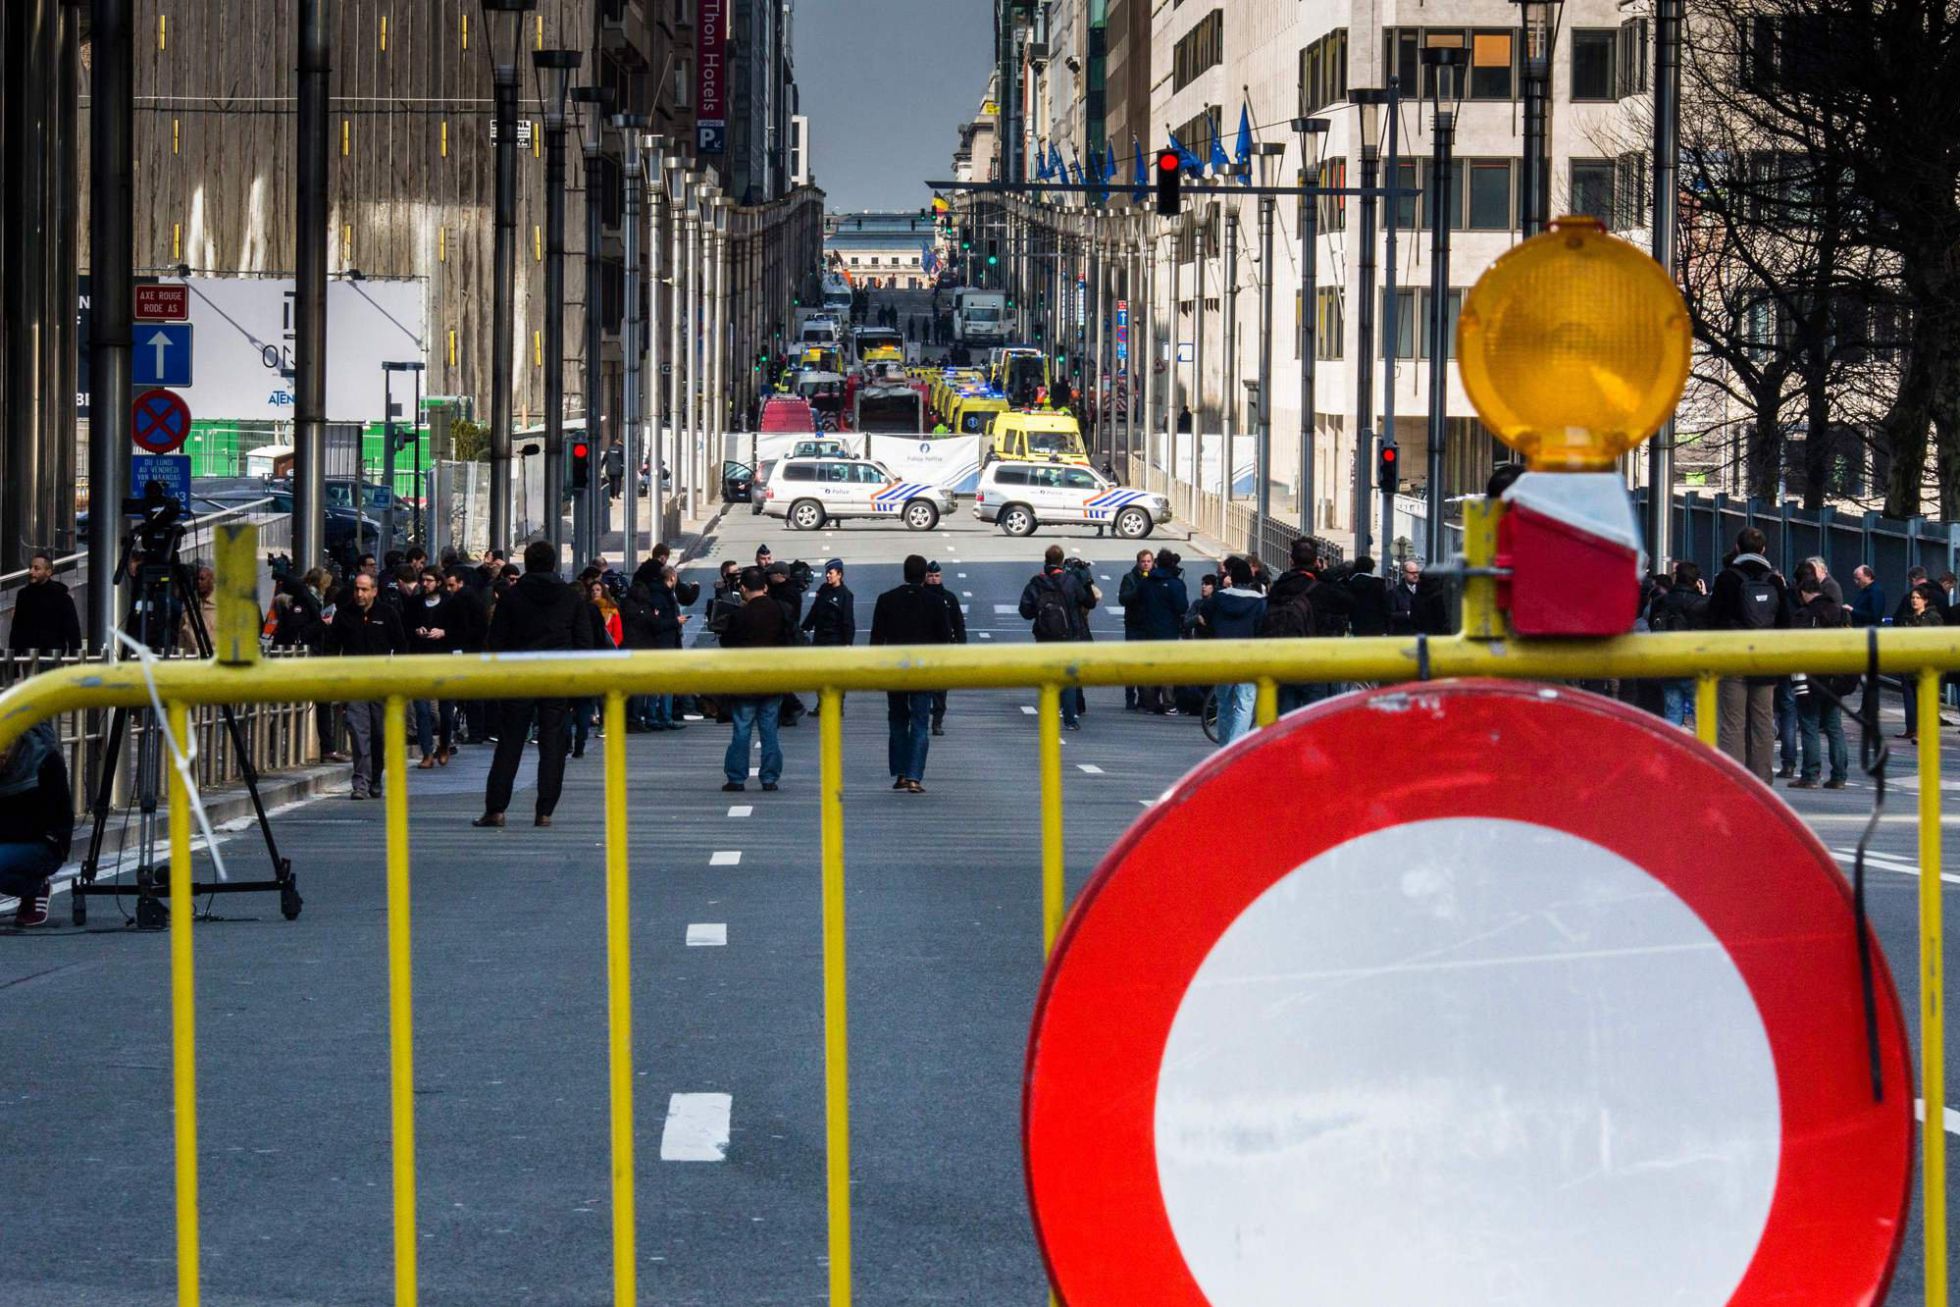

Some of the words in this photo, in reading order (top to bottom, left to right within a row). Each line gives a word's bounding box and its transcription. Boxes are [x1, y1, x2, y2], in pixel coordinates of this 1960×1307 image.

[704, 0, 720, 46] Thon
[704, 53, 720, 111] Hotels
[139, 290, 155, 300] AXE
[158, 291, 183, 301] ROUGE
[143, 303, 163, 313] RODE
[167, 304, 178, 313] AS
[268, 390, 296, 407] ATEN
